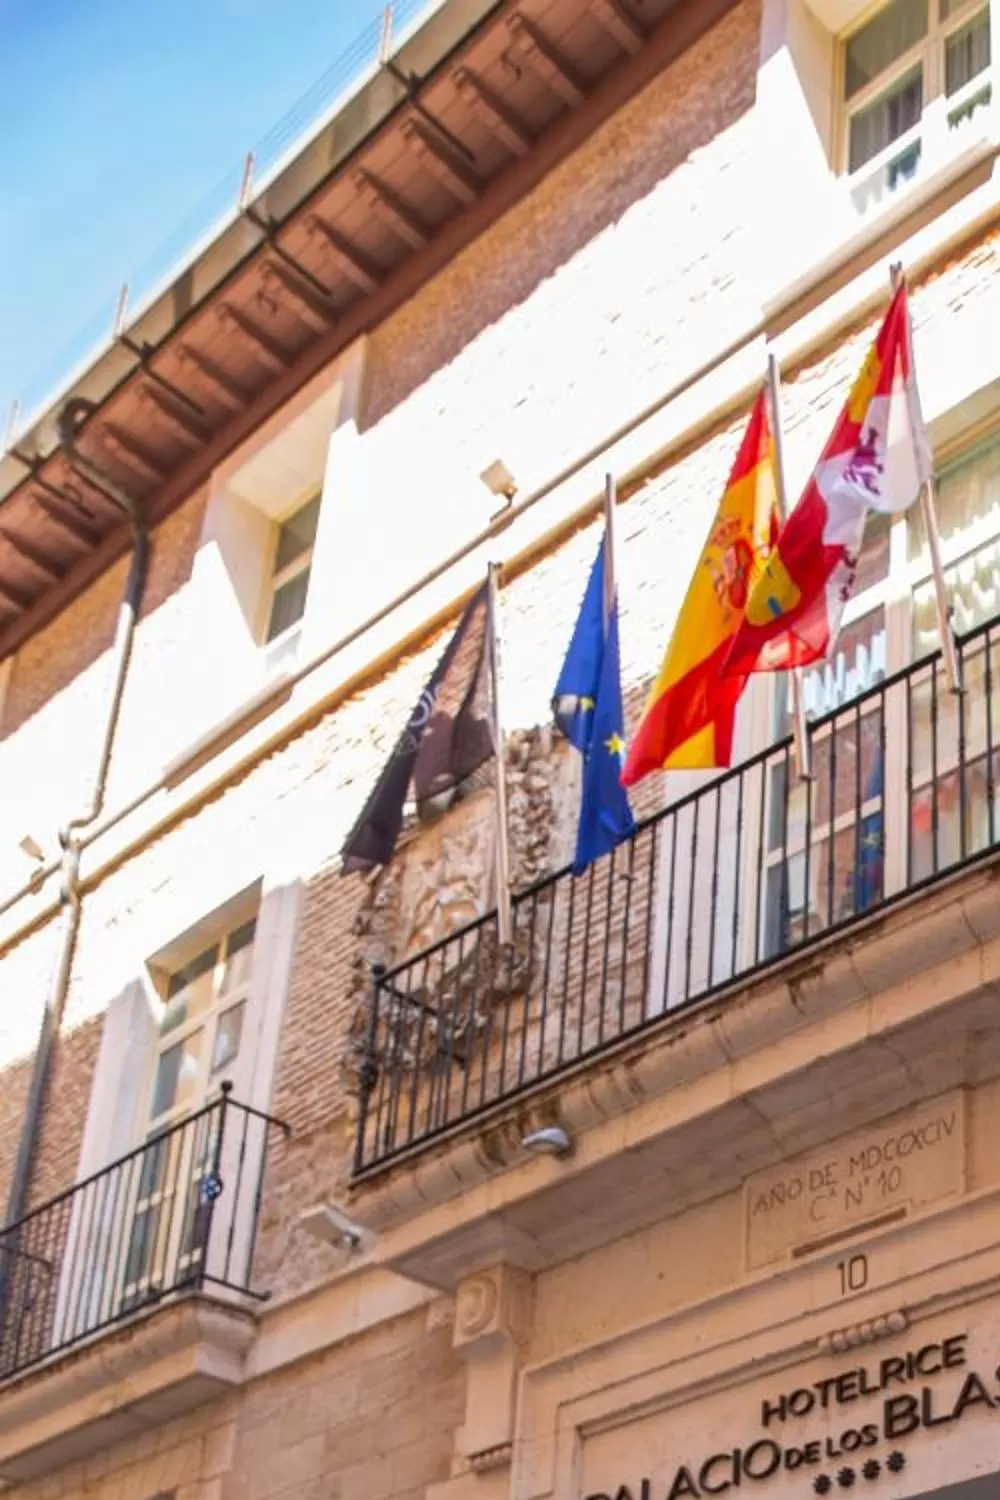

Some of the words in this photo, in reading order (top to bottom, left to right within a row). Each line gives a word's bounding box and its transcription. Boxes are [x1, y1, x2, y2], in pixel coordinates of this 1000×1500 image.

[808, 1161, 838, 1192] DE
[837, 1253, 868, 1296] 10
[784, 1441, 820, 1470] DE
[826, 1424, 879, 1458] LOS
